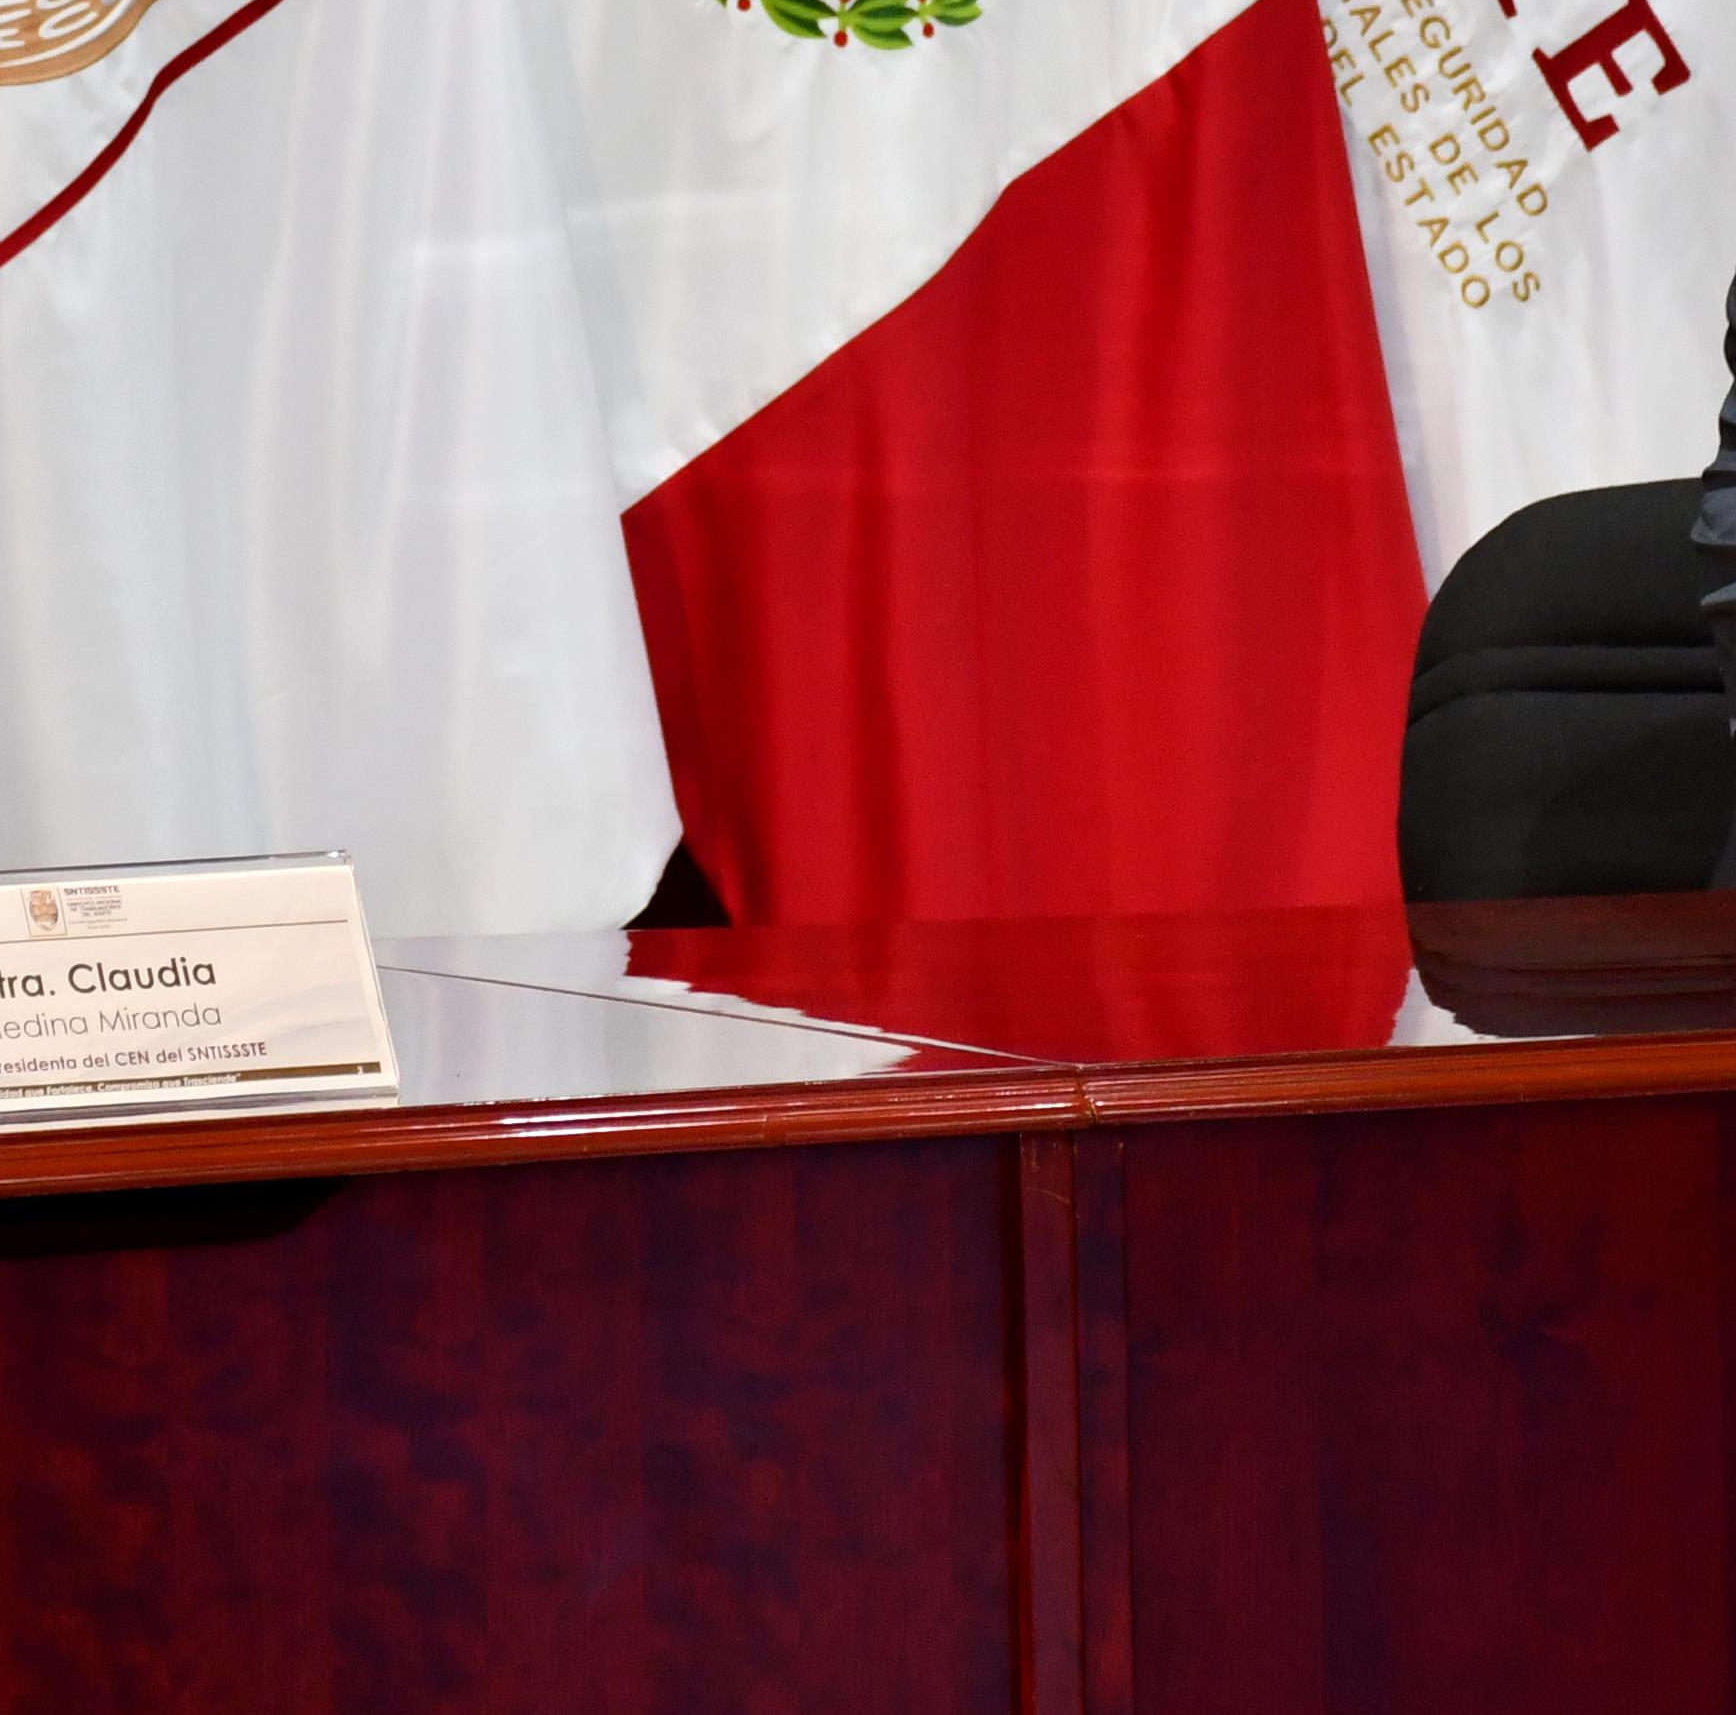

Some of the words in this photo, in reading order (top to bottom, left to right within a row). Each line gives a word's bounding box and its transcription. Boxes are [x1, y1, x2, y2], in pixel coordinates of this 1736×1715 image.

[1367, 122, 1492, 311] ESTADO
[1428, 129, 1480, 193] DE
[1475, 210, 1542, 305] LOS
[67, 956, 217, 996] Claudia
[97, 1001, 223, 1032] Miranda
[82, 1052, 110, 1070] del
[114, 1051, 151, 1066] CEN
[155, 1047, 184, 1063] del
[187, 1042, 268, 1062] SNTISSSTE
